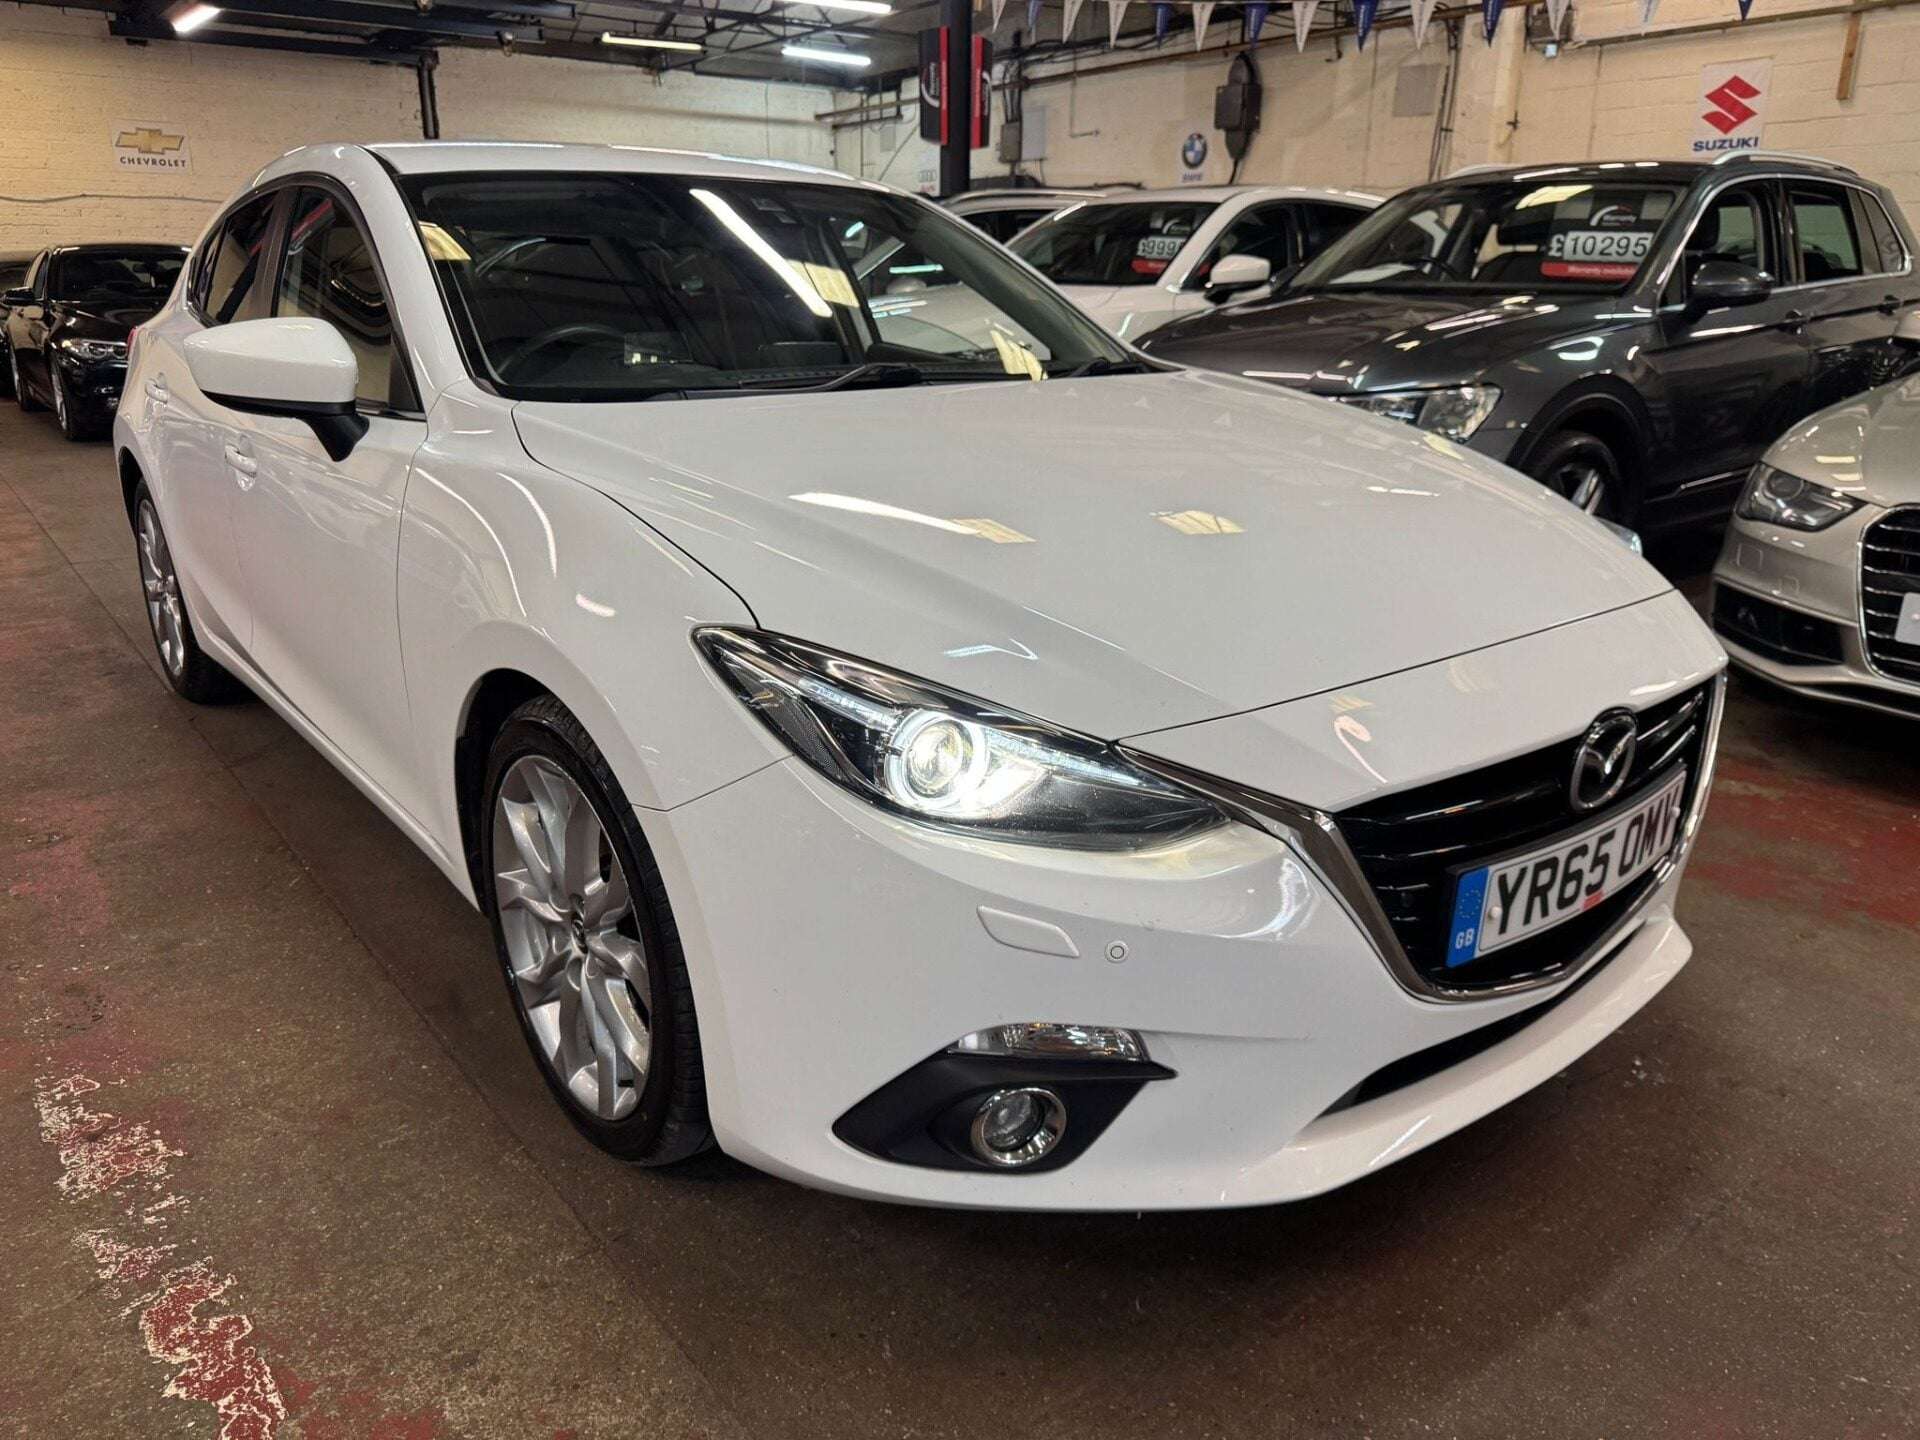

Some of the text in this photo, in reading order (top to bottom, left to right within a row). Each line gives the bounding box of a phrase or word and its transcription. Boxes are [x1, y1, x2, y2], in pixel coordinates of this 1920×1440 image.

[1693, 136, 1759, 151] SUZUKI
[119, 156, 186, 167] CHEVROLET
[1137, 238, 1186, 256] £999
[1498, 829, 1617, 935] YR65
[1455, 928, 1475, 950] GB
